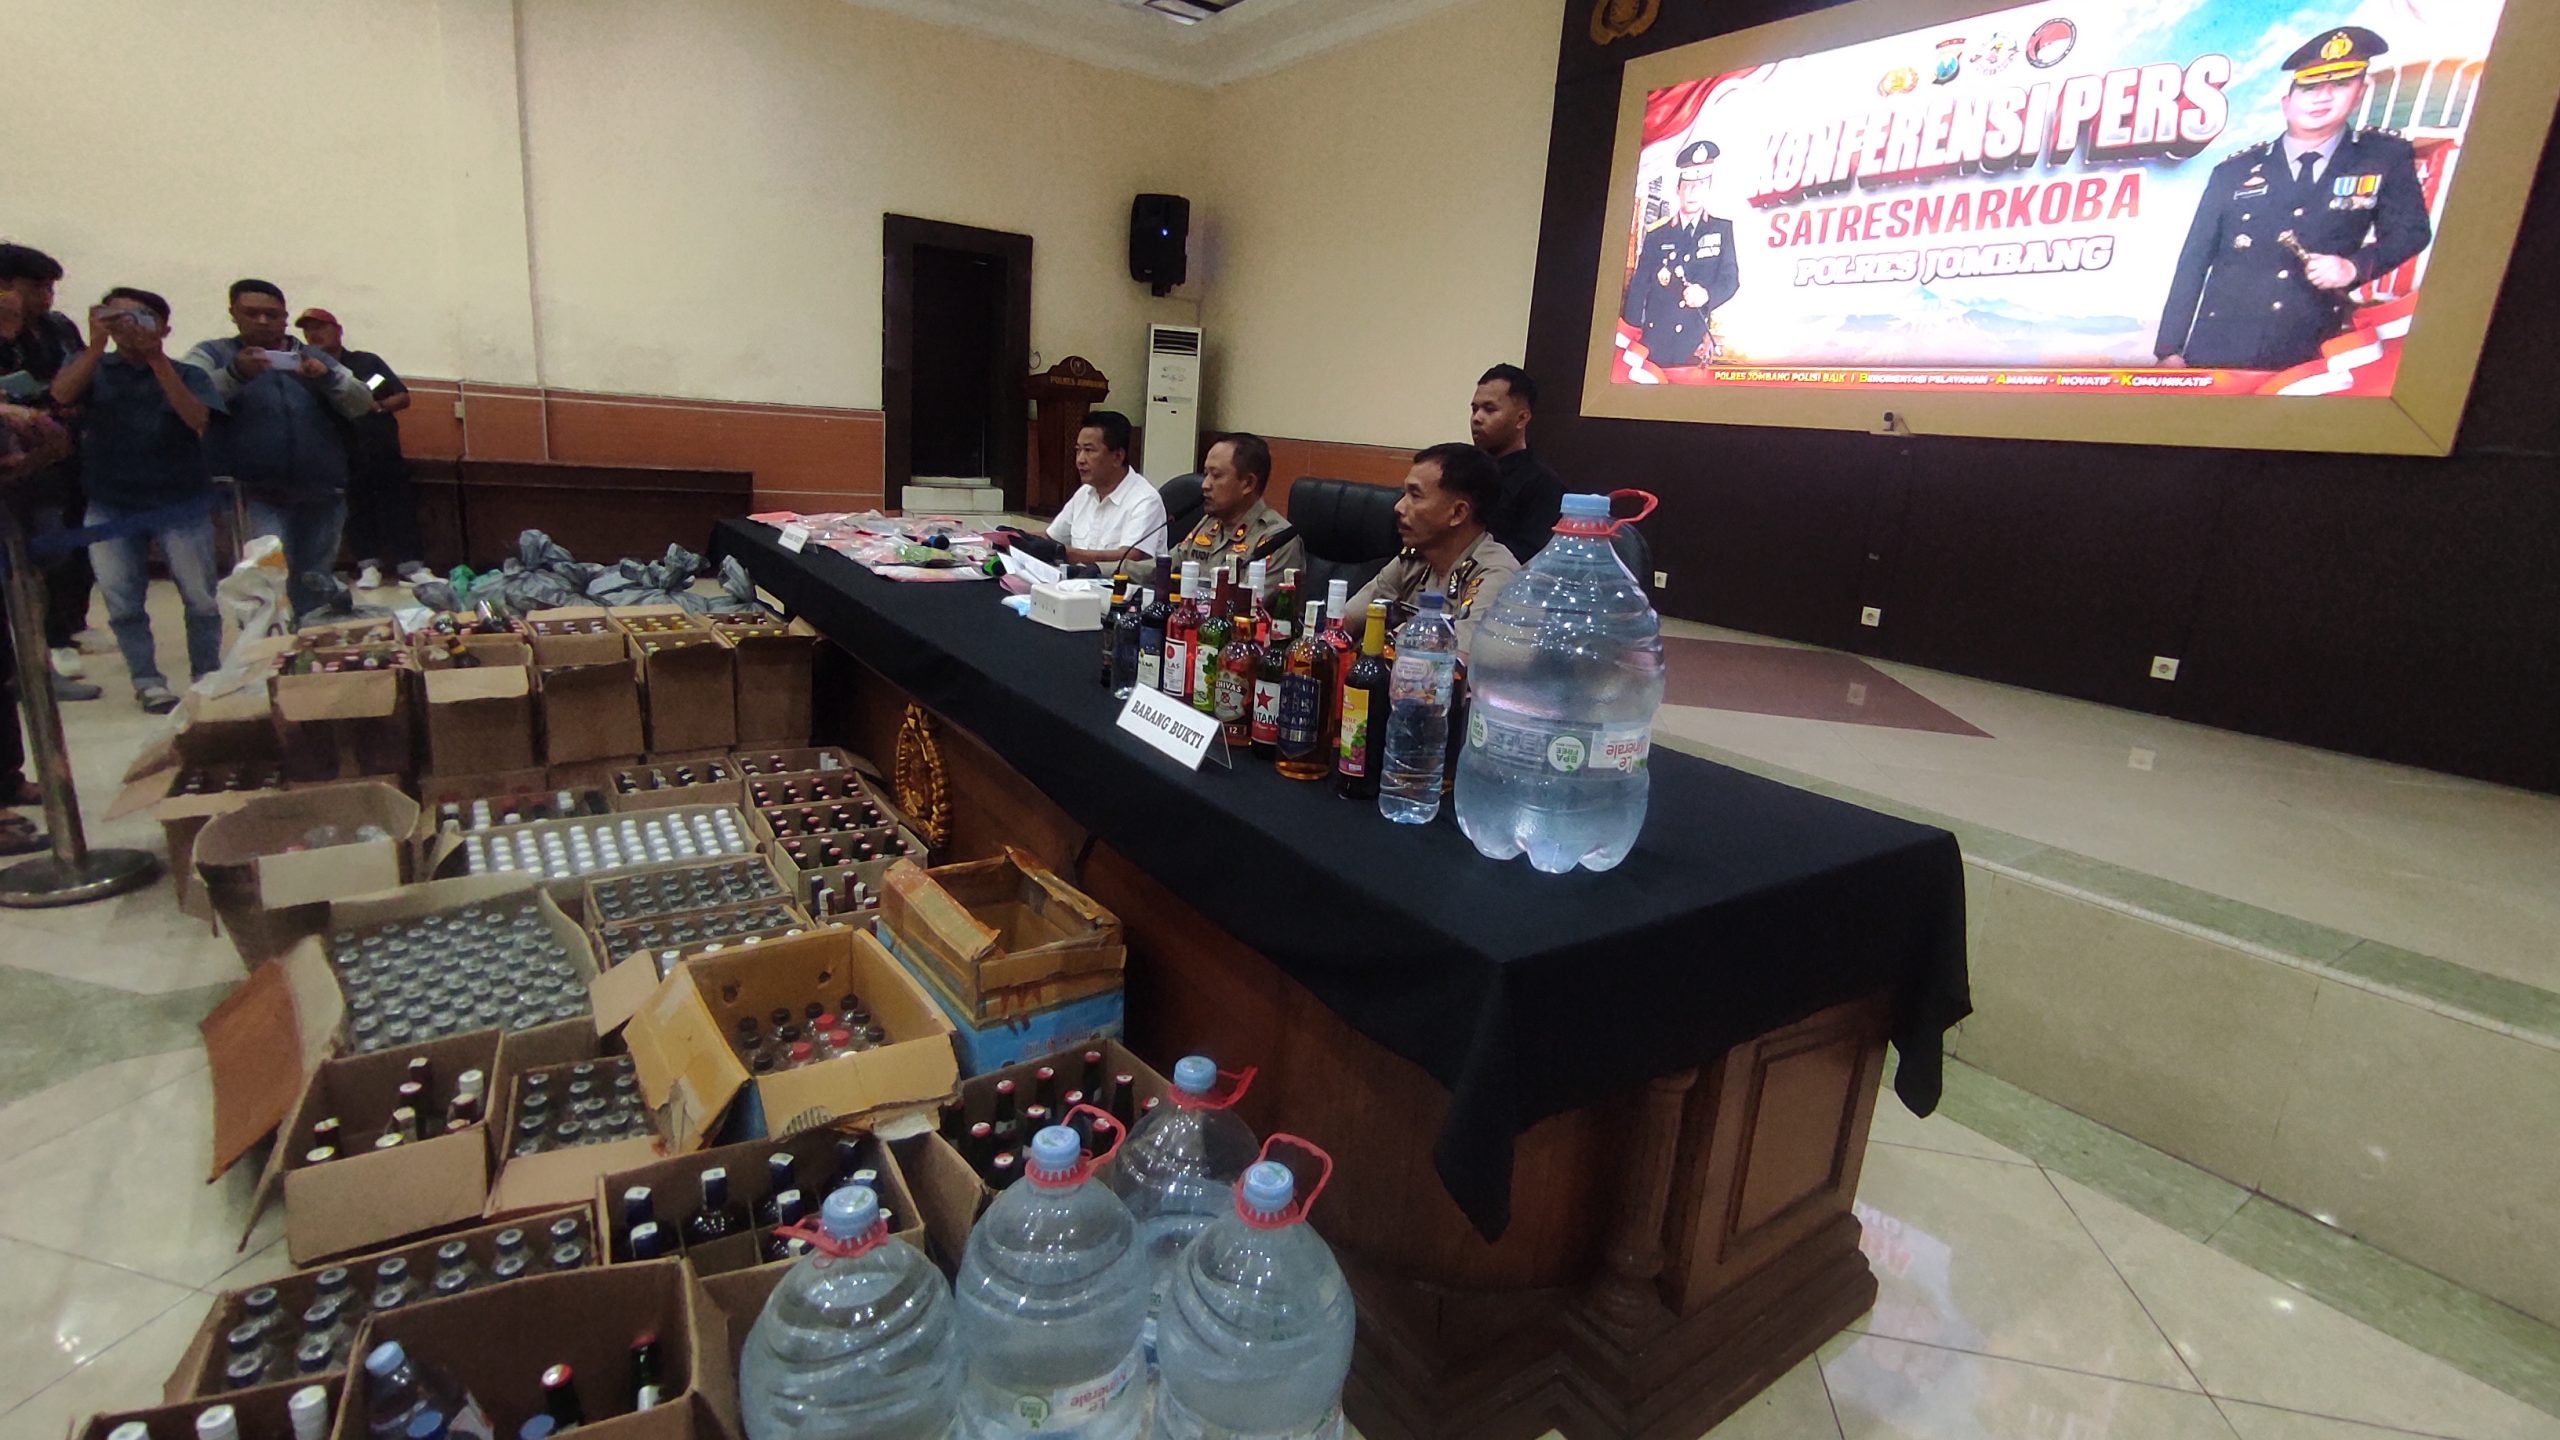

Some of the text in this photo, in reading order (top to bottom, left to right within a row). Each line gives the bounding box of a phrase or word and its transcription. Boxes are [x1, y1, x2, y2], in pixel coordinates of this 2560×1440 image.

[1753, 53, 2231, 203] KONFERENSI PERS
[1768, 173, 2140, 248] SATRESNARKOBA
[1794, 236, 2115, 286] POLRES JOMBANG
[2056, 374, 2111, 386] INOVATIF
[1131, 700, 1205, 750] BARANG BUKTI
[1555, 746, 1579, 756] FREE
[1556, 754, 1578, 764] BPA
[1618, 755, 1633, 773] Le
